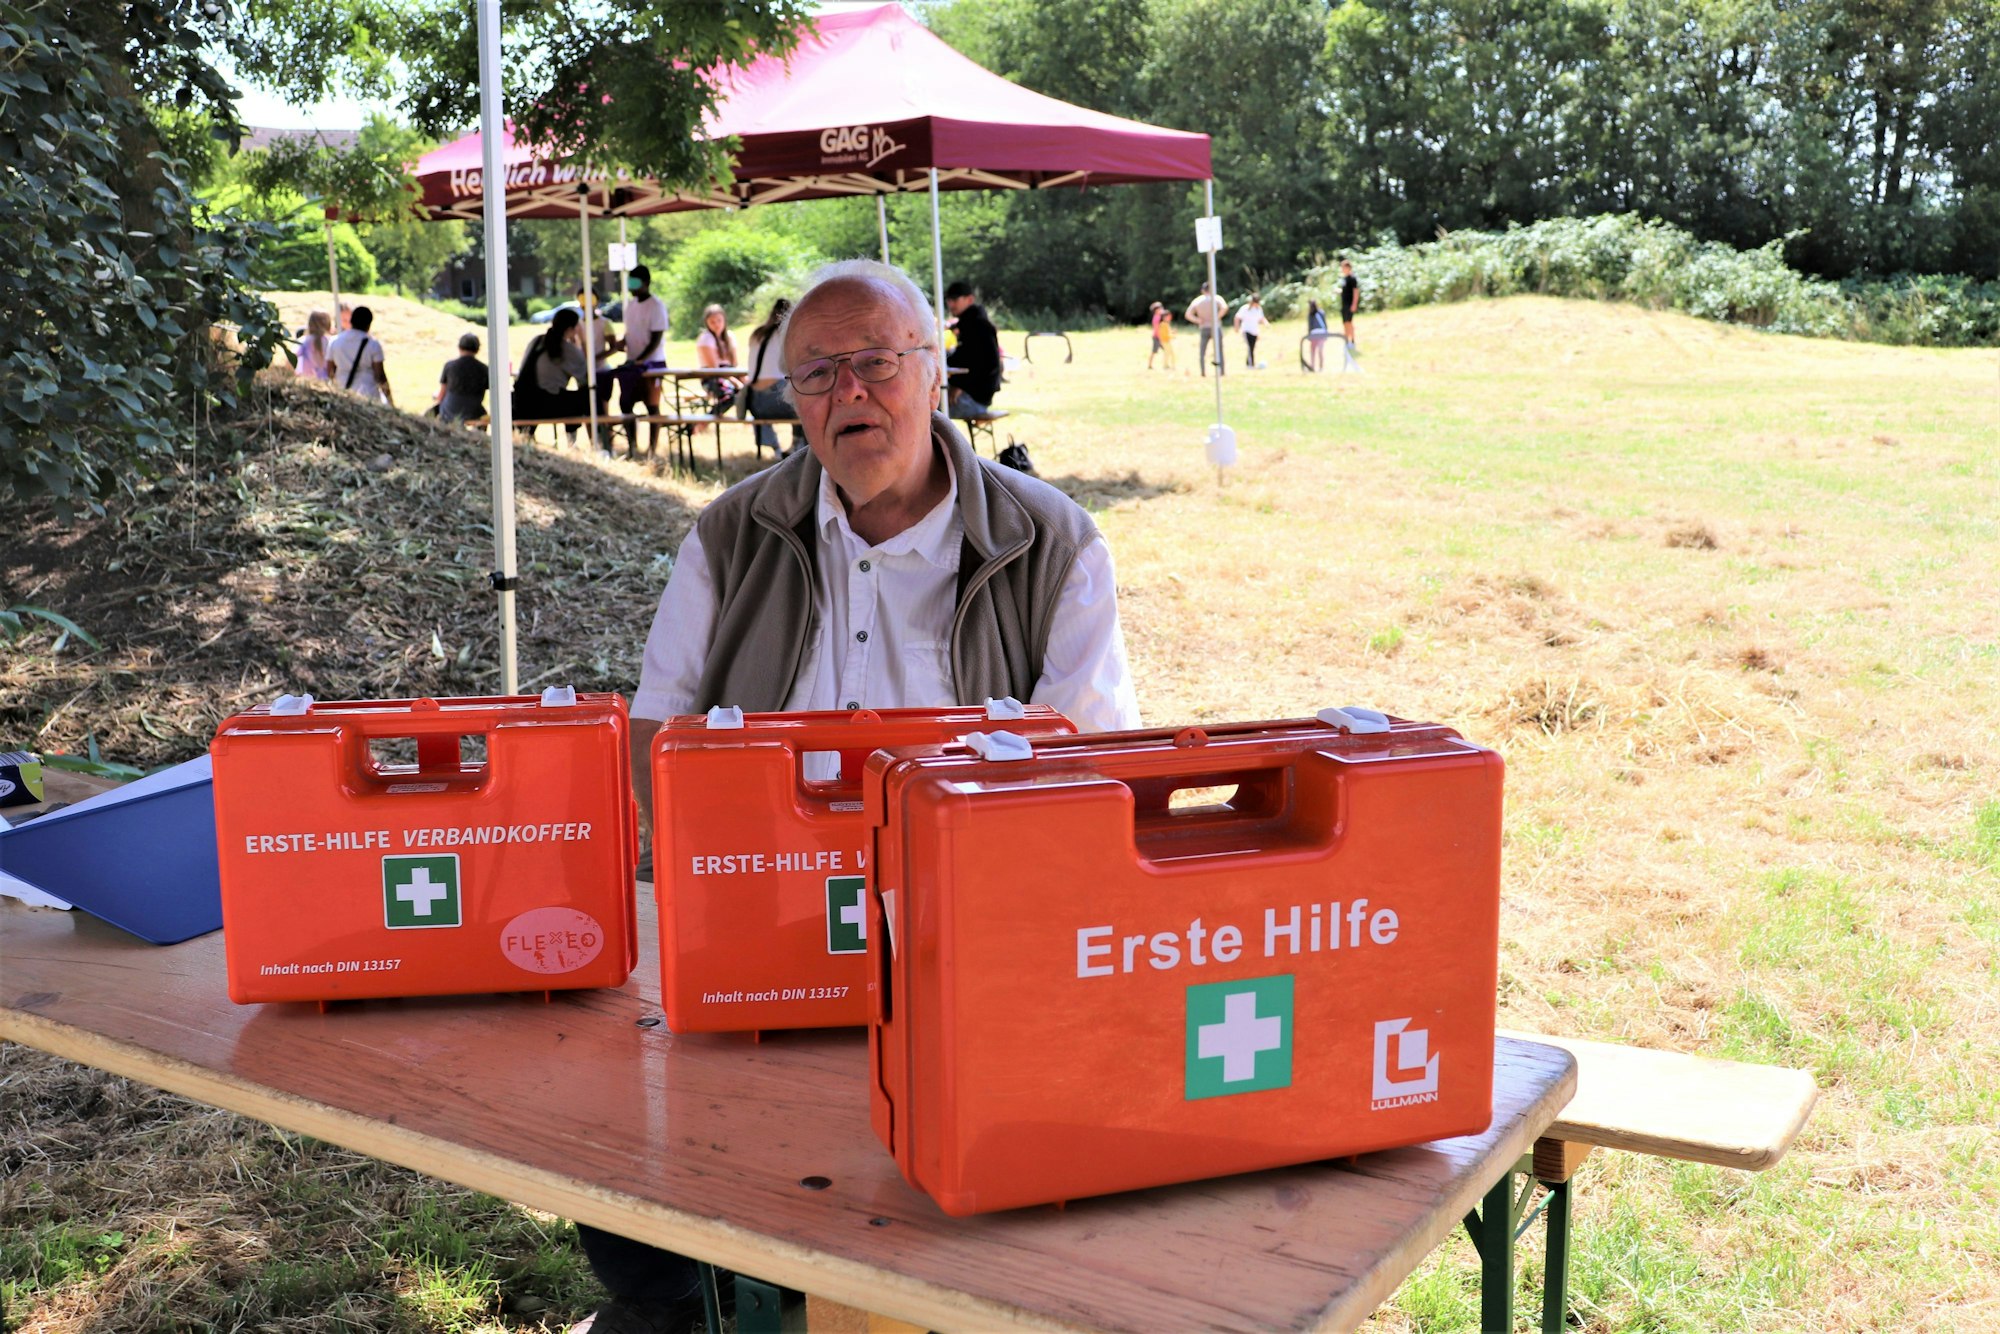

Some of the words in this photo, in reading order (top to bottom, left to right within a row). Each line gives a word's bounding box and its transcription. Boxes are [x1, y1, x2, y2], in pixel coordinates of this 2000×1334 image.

[820, 125, 869, 153] GAG
[450, 156, 547, 197] Helich
[245, 830, 391, 854] ERSTE-HILFE
[402, 822, 592, 848] VERBANDKOFFER
[692, 851, 843, 875] ERSTE-HILFE
[507, 931, 596, 951] FLEXEO
[1076, 917, 1243, 978] Erste
[1264, 898, 1399, 957] Hilfe
[260, 963, 299, 975] Inhalt
[302, 962, 333, 974] nach
[336, 960, 360, 972] DIN
[362, 959, 401, 971] 13157
[702, 991, 743, 1003] Inhalt
[745, 989, 778, 1002] nach
[781, 988, 806, 1000] DIN
[808, 986, 849, 999] 13157
